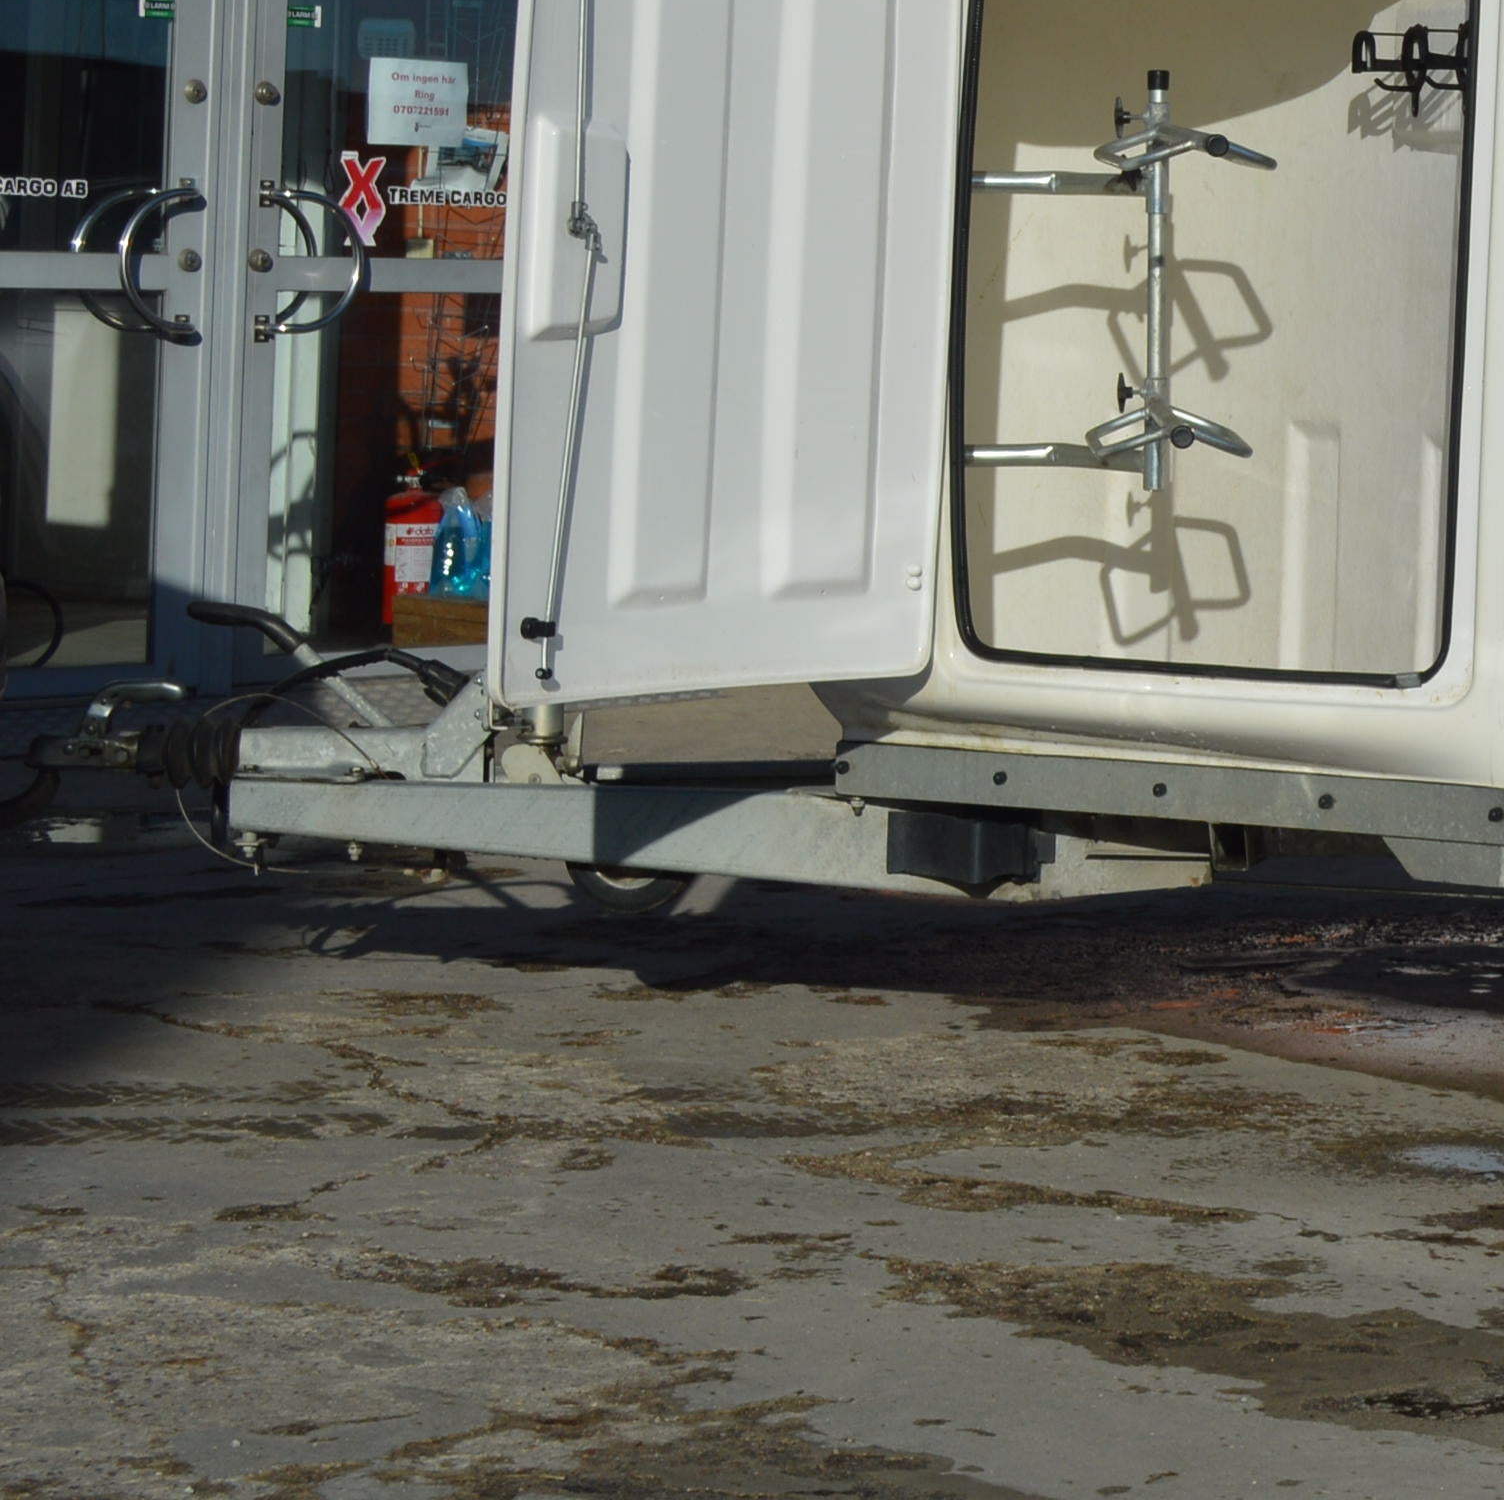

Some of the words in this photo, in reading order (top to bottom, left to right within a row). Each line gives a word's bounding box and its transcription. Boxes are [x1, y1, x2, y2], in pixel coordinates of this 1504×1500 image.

[391, 72, 409, 81] Om
[413, 73, 439, 85] ingen
[415, 90, 435, 102] Ring
[0, 177, 57, 196] ARGO
[62, 180, 88, 198] AB
[451, 190, 507, 206] CARGO
